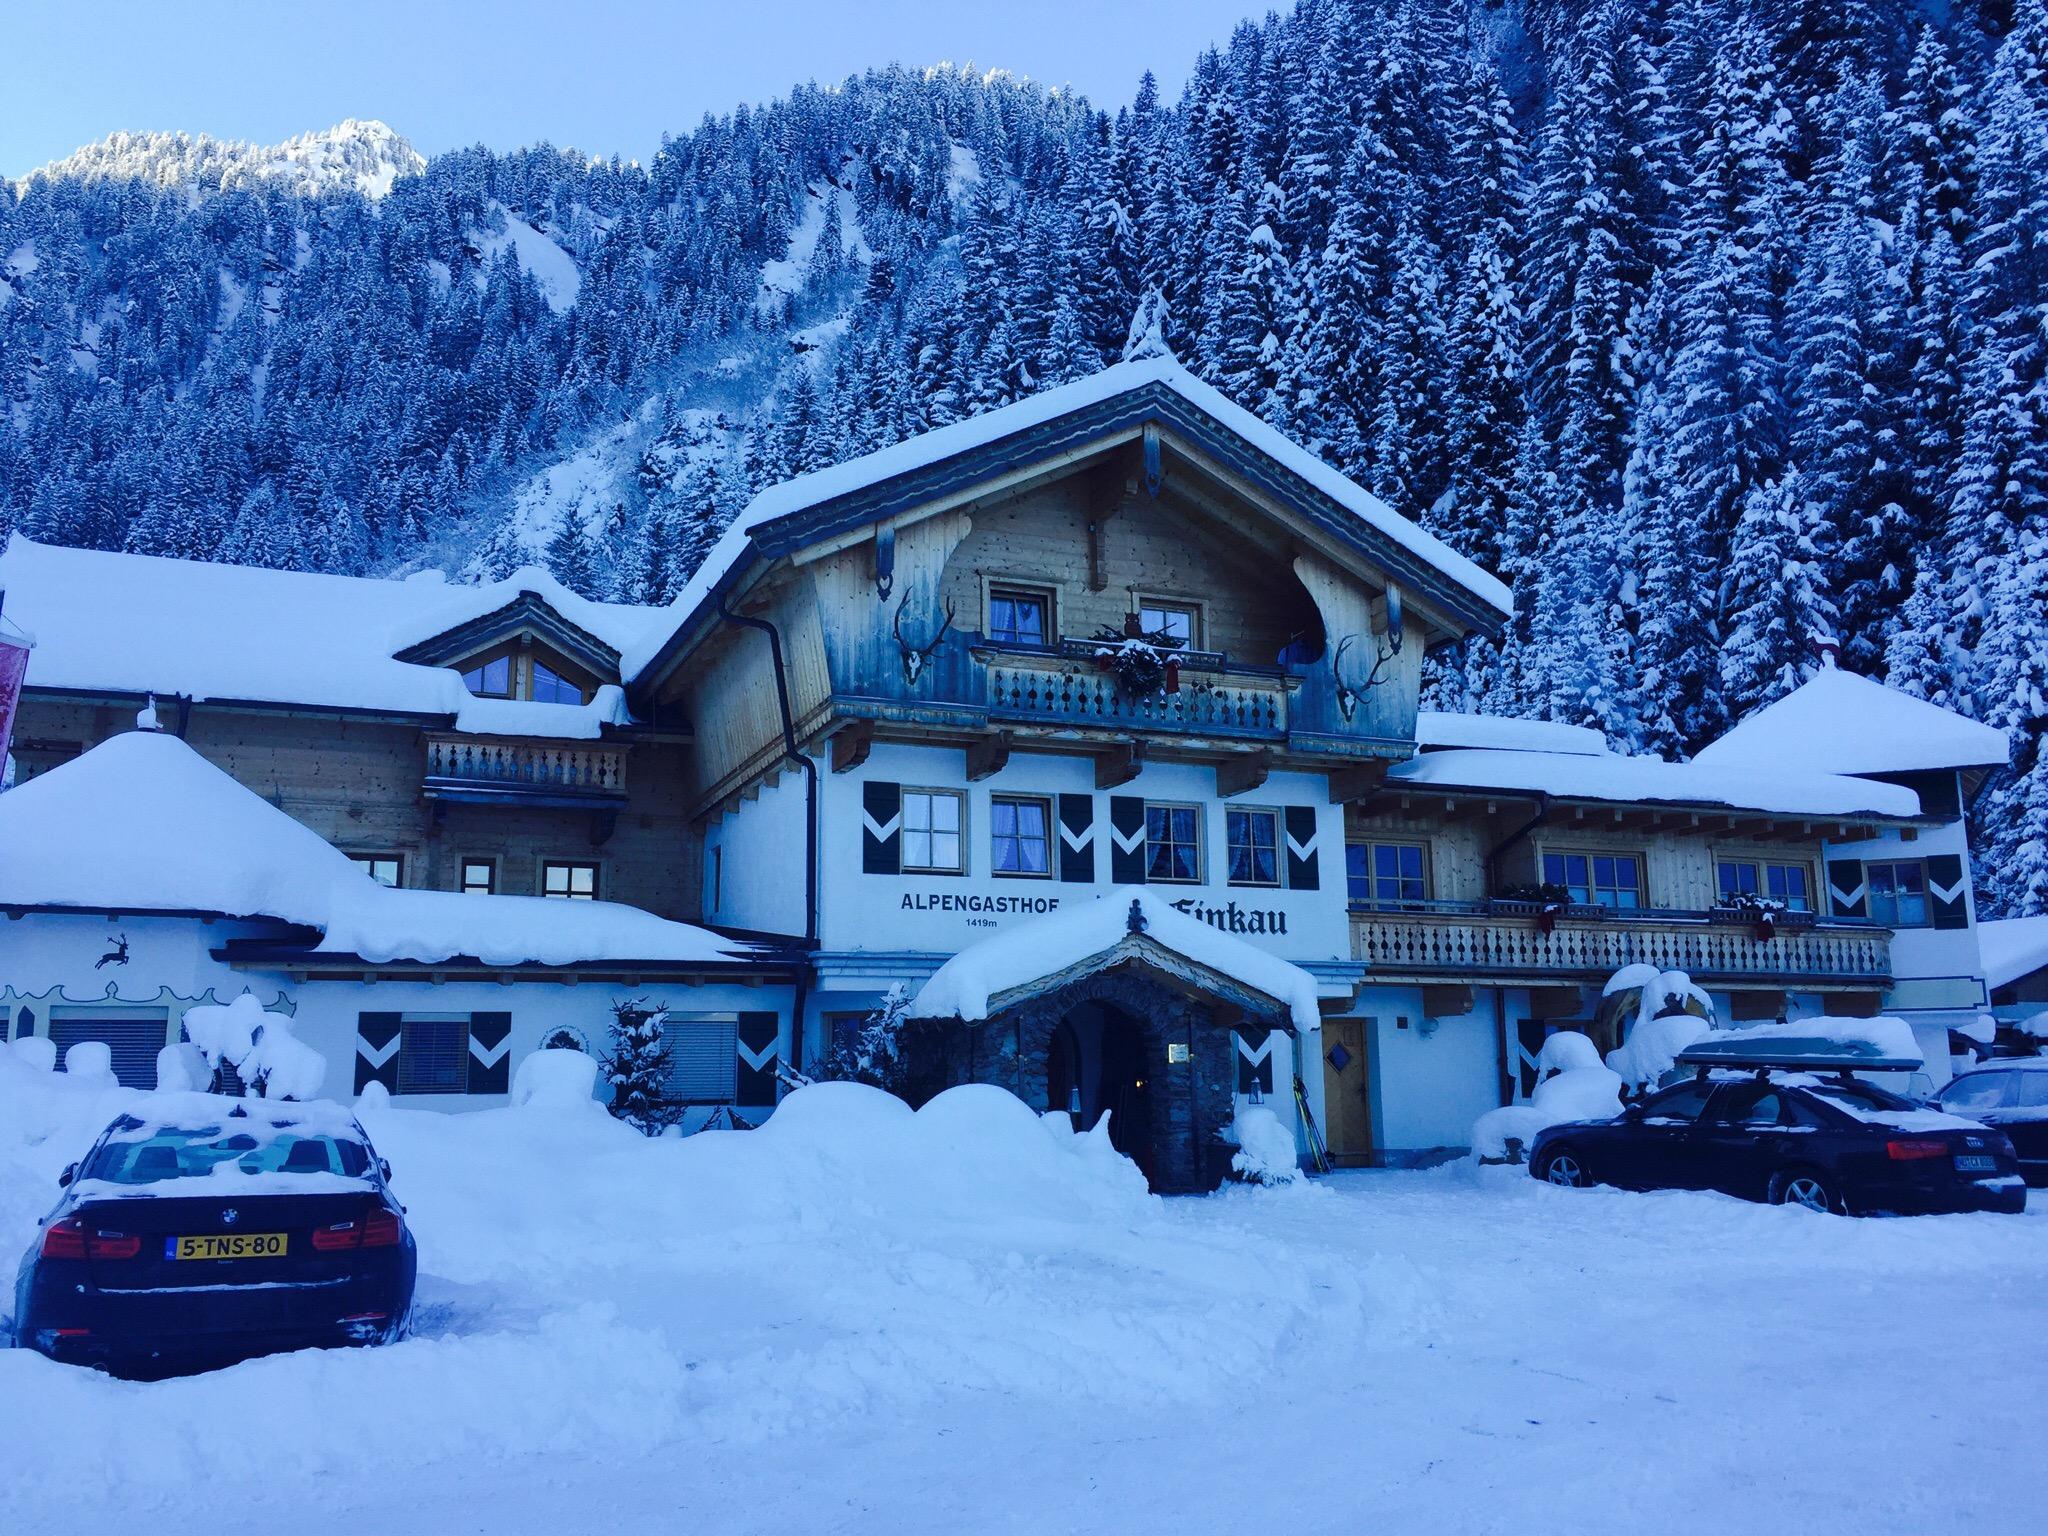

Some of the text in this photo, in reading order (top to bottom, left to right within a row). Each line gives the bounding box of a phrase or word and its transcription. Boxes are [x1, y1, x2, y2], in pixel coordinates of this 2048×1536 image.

[900, 893, 1060, 914] ALPENGASTHOF
[965, 918, 998, 928] 1419m
[182, 1235, 281, 1257] 5-TNS-80
